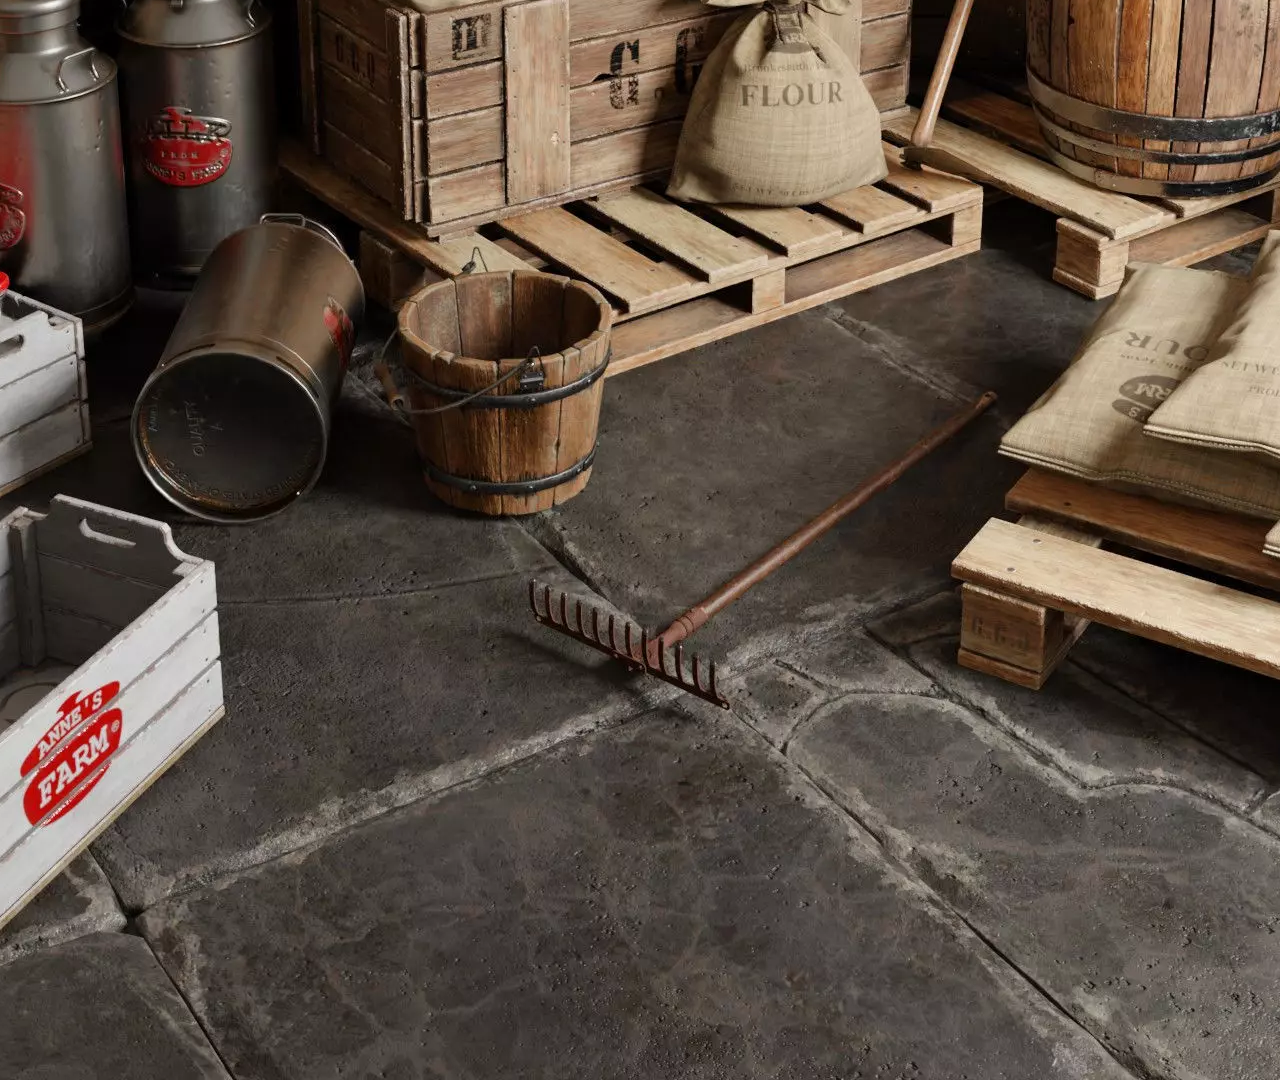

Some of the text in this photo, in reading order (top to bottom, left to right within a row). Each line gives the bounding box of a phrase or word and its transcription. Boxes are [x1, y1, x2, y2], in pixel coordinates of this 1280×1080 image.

[740, 80, 843, 107] FLOUR
[37, 689, 103, 762] ANNE'S
[37, 723, 111, 809] FARM
